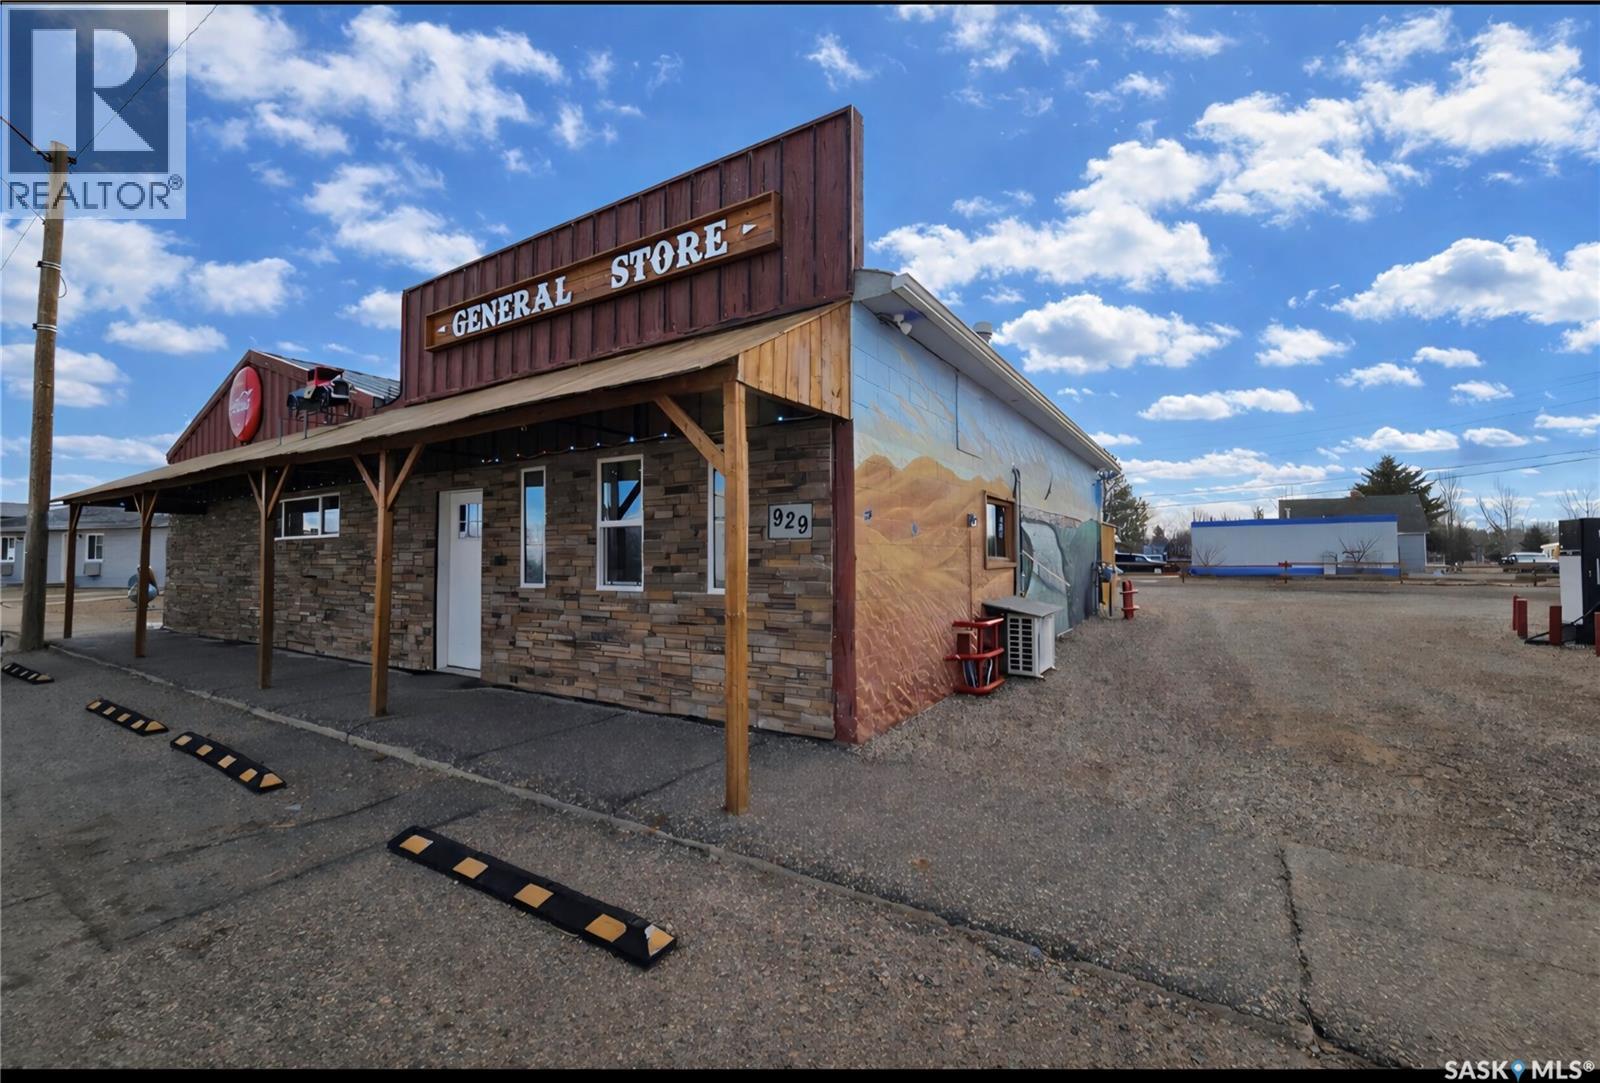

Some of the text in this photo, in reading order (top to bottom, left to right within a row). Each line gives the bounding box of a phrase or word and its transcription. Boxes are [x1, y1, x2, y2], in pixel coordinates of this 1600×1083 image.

[452, 219, 728, 337] GENERAL STORE
[773, 508, 808, 534] 929
